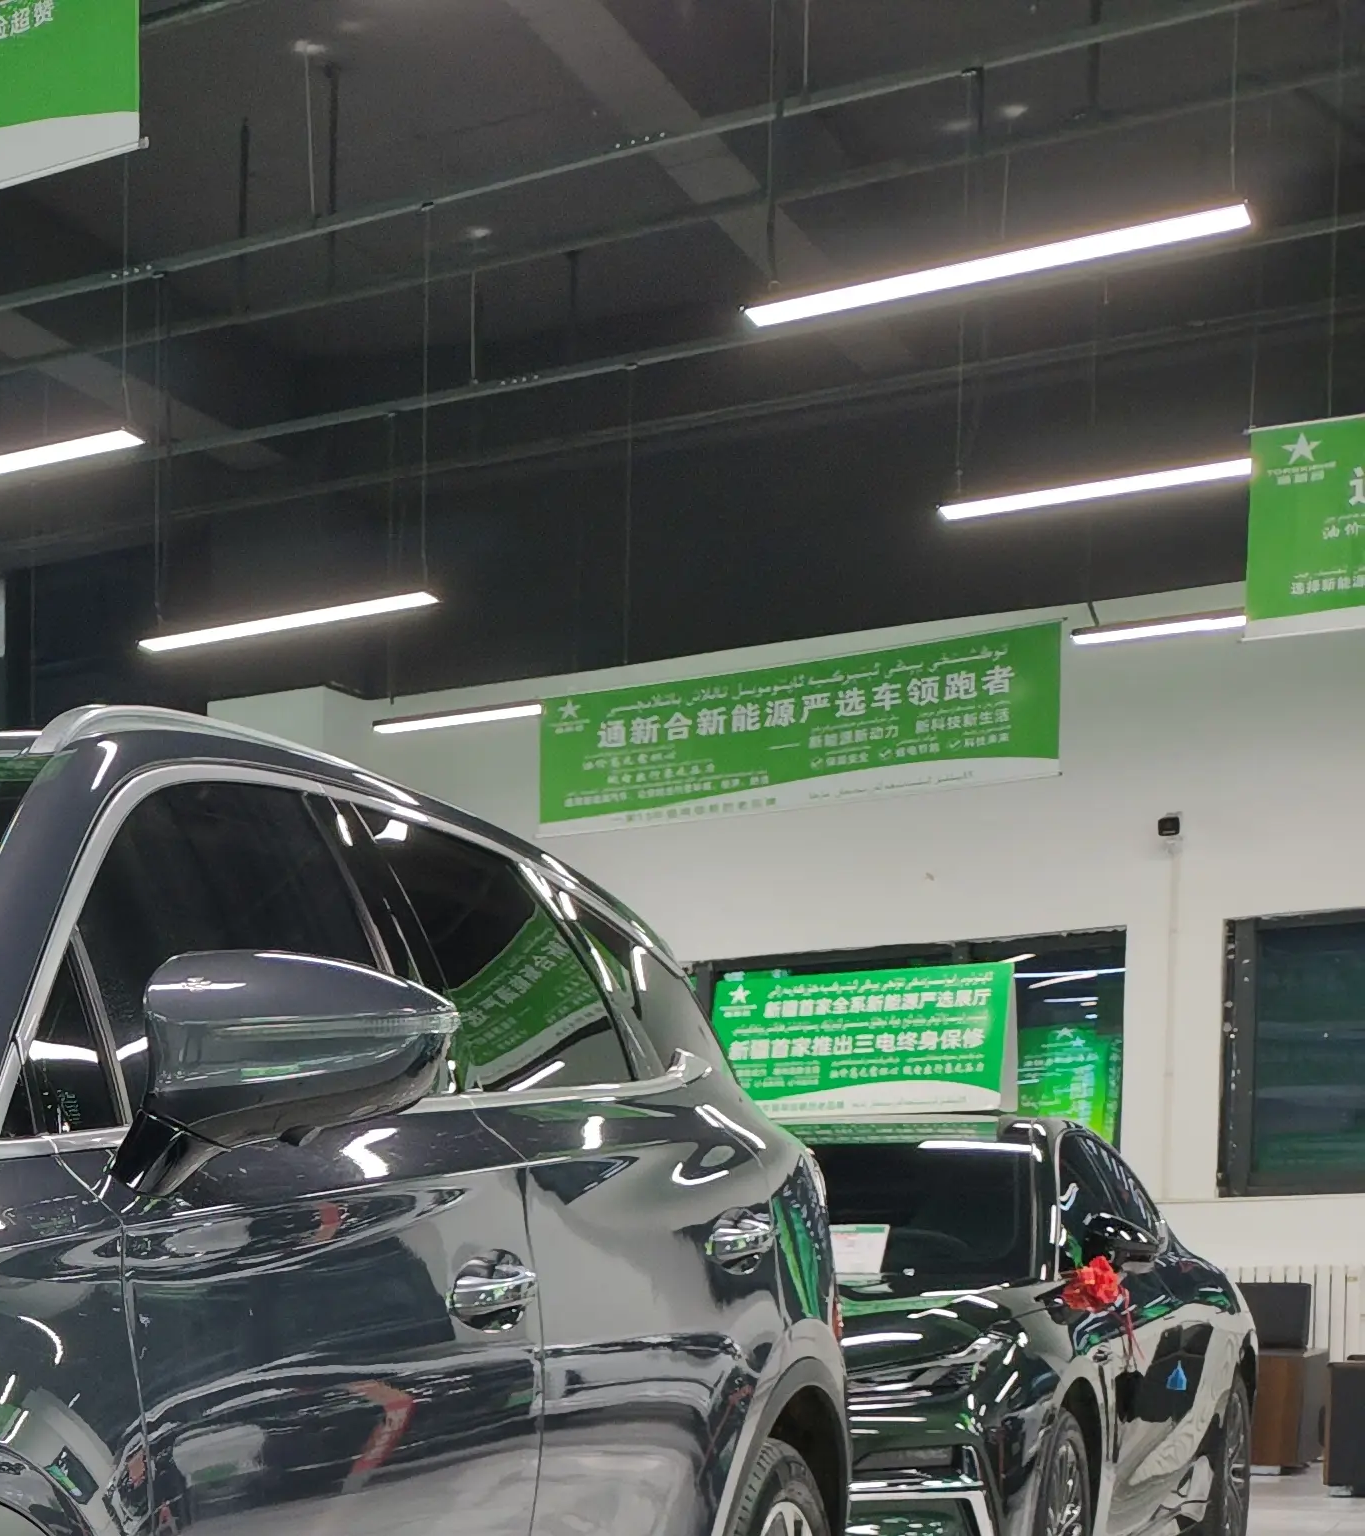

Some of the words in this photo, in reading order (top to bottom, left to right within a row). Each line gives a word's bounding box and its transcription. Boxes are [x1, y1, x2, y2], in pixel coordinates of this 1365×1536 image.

[597, 664, 1016, 748] 通新合新能源严选车领跑者
